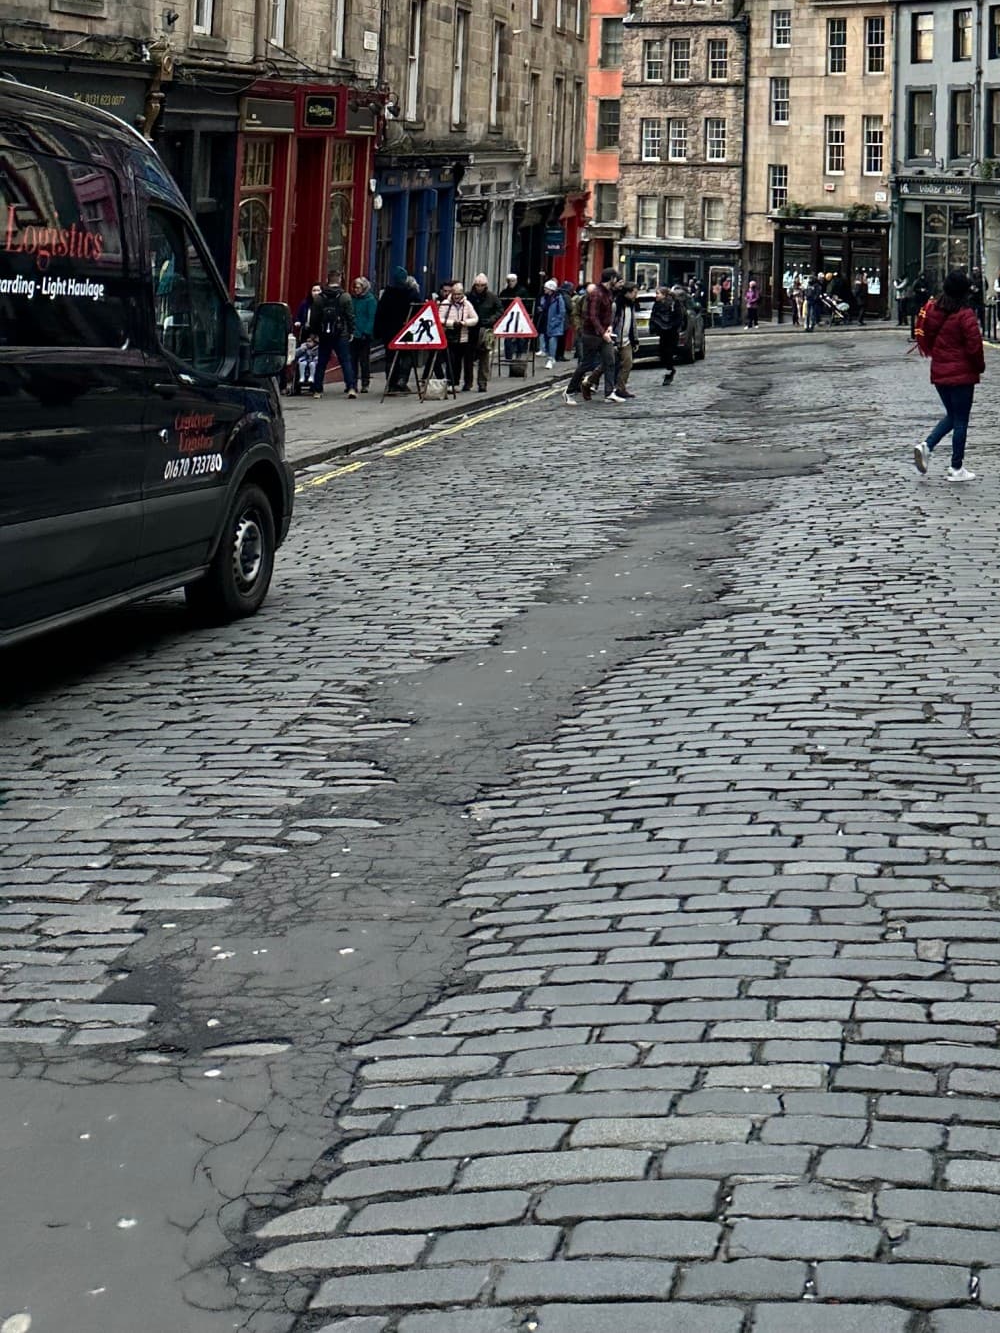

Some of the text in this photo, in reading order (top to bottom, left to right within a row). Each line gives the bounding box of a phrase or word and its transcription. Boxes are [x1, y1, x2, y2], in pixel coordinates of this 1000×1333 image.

[5, 203, 103, 270] Logistics
[42, 276, 66, 300] Light
[67, 278, 105, 301] Haulage
[164, 453, 223, 479] 01670 733780
